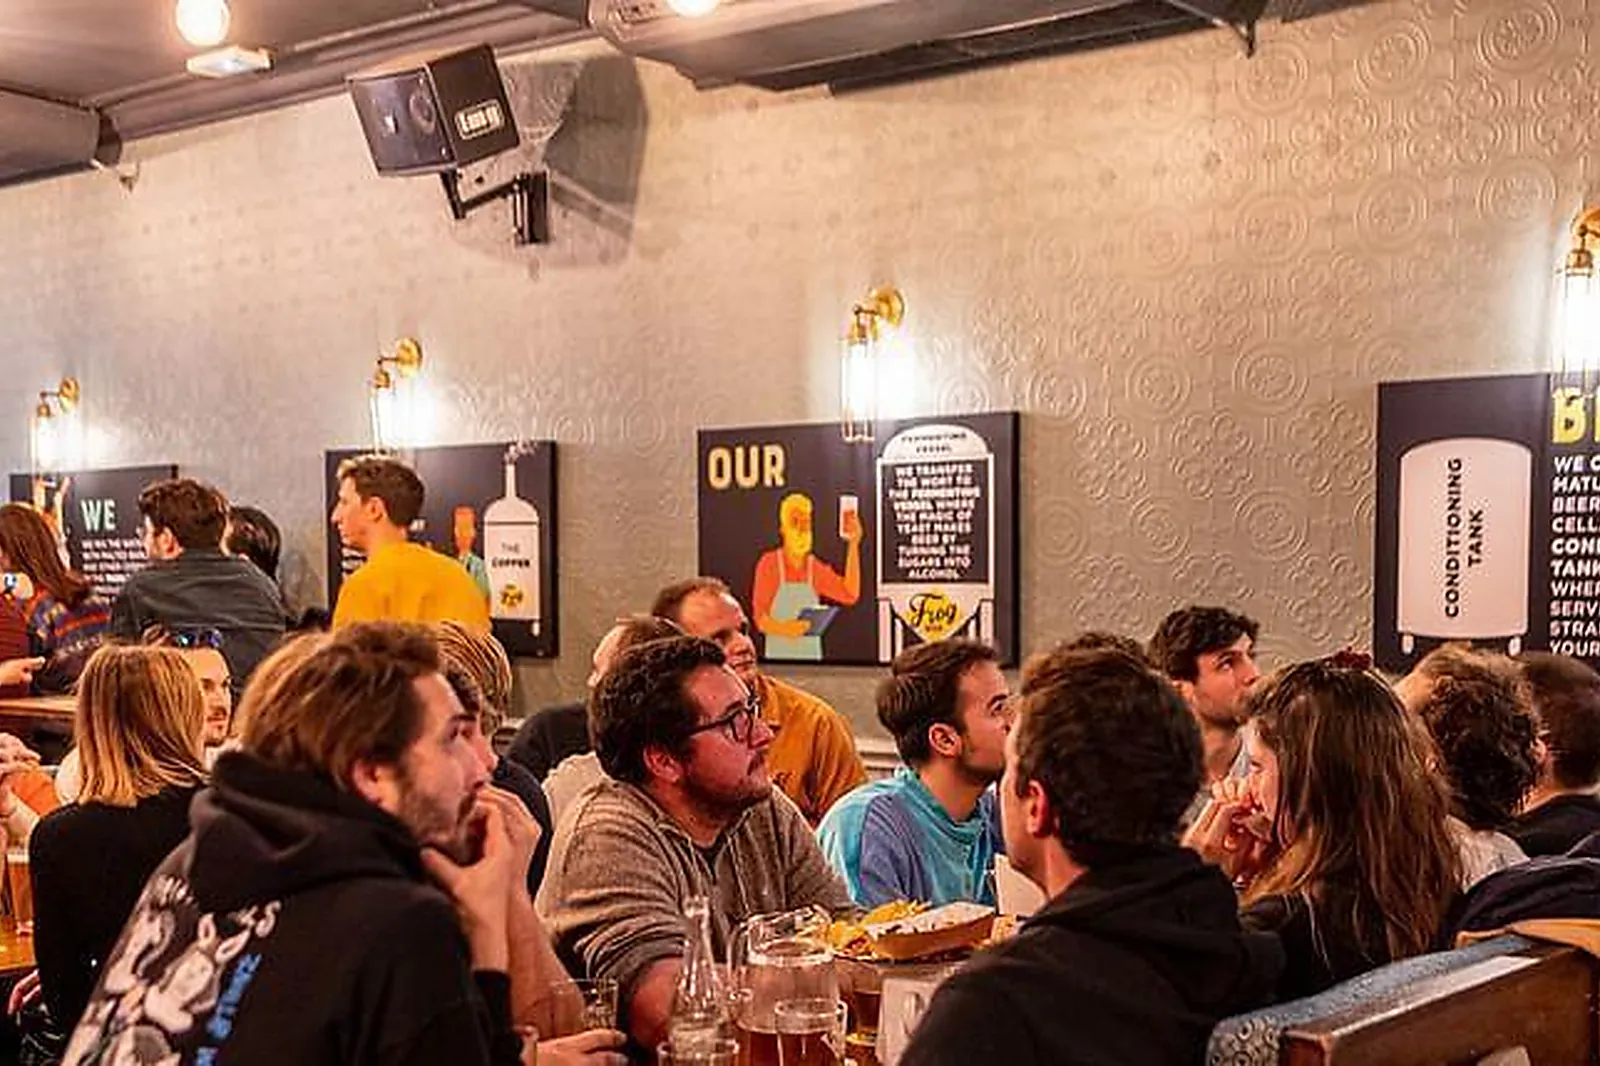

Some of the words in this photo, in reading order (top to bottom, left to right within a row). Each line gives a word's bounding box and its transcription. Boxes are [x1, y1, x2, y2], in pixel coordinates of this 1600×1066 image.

[1552, 386, 1600, 443] B
[708, 444, 785, 490] OUR
[1554, 455, 1585, 473] WE
[81, 499, 115, 532] WE
[1552, 495, 1600, 513] BEER
[1551, 516, 1600, 533] CELL
[1445, 458, 1462, 617] CONDITIONING
[1468, 508, 1484, 567] TANK
[909, 593, 957, 628] Frog
[1549, 600, 1600, 617] SERV
[1549, 619, 1600, 637] STRA
[1549, 639, 1600, 656] YOUR
